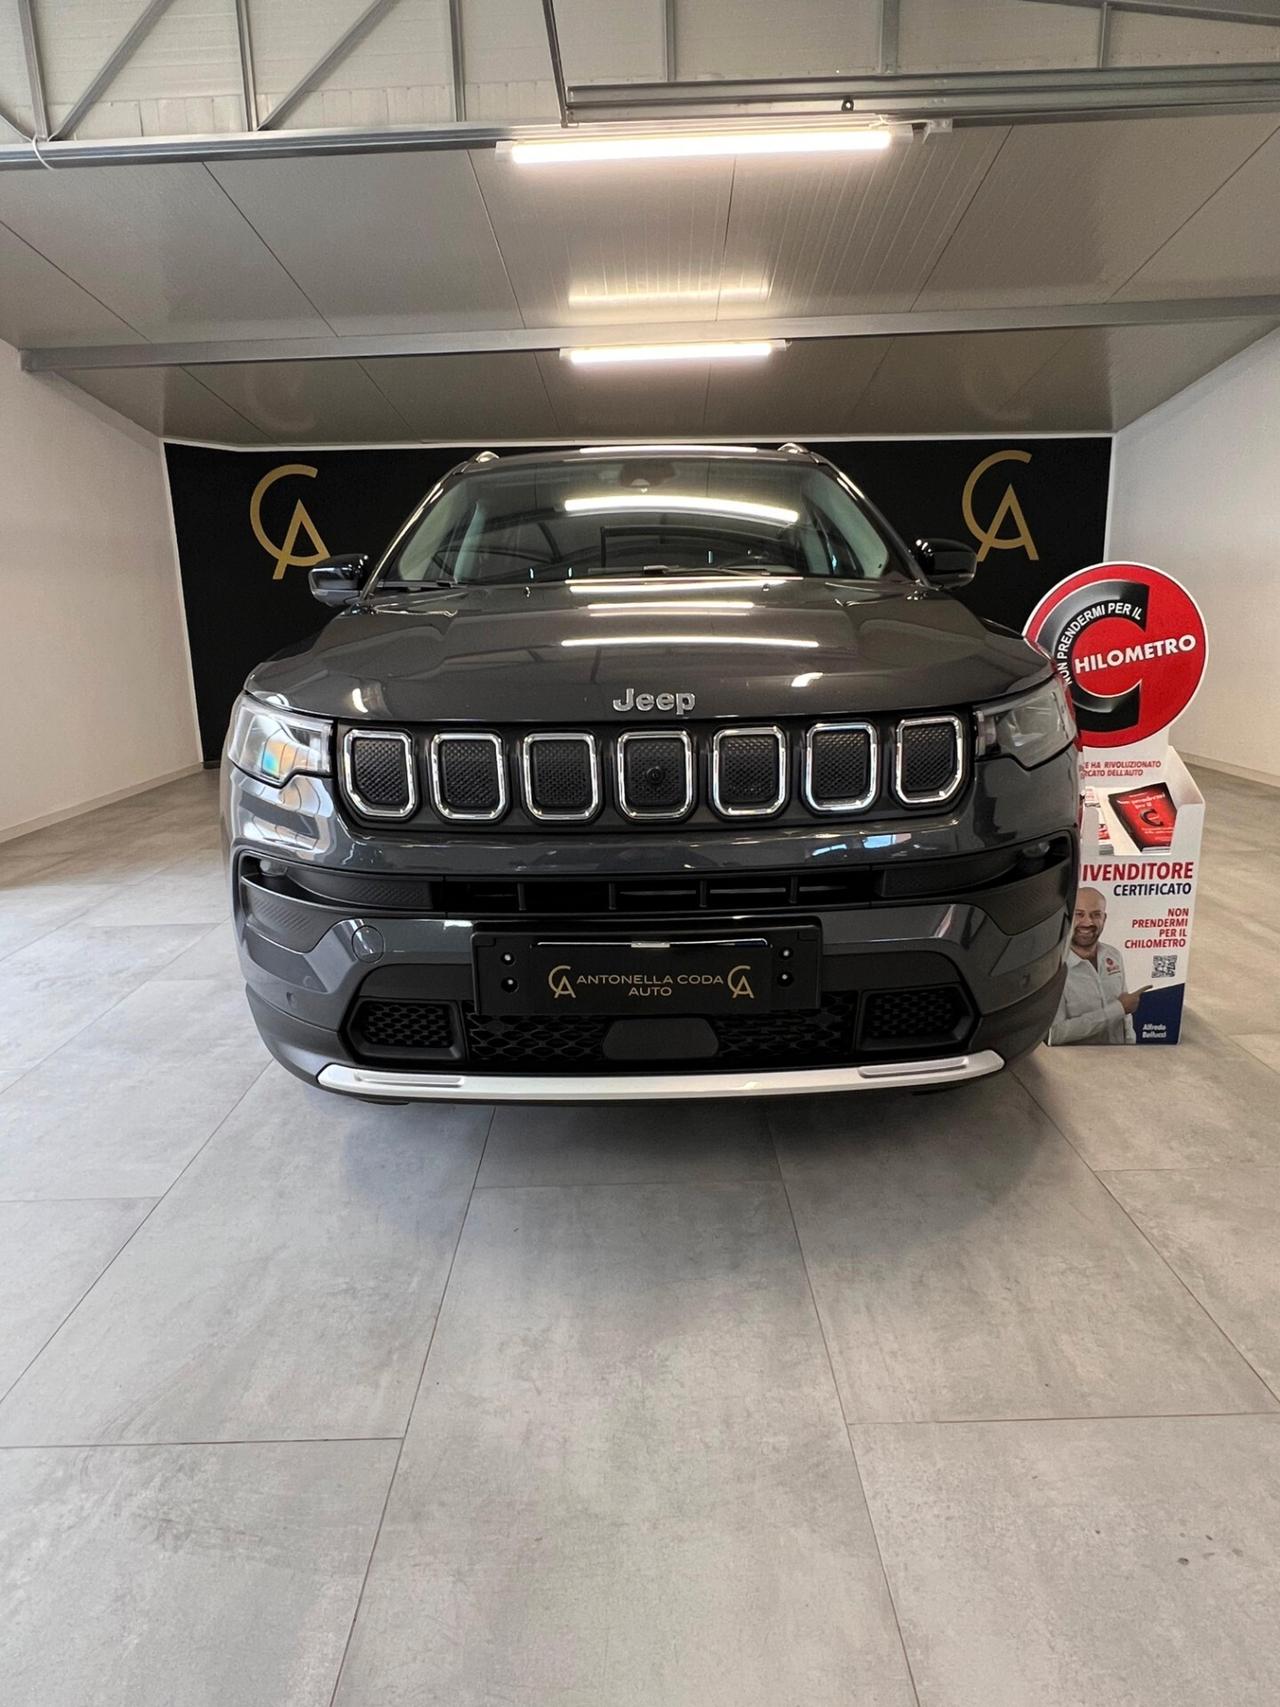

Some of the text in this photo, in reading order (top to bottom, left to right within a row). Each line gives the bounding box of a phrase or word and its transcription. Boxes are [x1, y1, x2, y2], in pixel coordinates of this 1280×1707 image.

[1057, 604, 1106, 659] PRENDERMI
[1107, 602, 1132, 615] PER
[1131, 606, 1143, 621] IL
[612, 688, 696, 715] Jeep
[1104, 760, 1162, 769] RIVOLUZIONATO
[1081, 862, 1195, 882] IVENDITORE
[1113, 882, 1192, 896] CERTIFICATO
[1167, 908, 1189, 917] NON
[1132, 918, 1188, 928] PRENDERMI
[1159, 928, 1188, 938] PER IL
[1124, 938, 1186, 949] CHILOMETRO
[576, 974, 674, 985] ANTONELLA
[677, 974, 724, 985] CODA
[628, 986, 672, 997] AUTO
